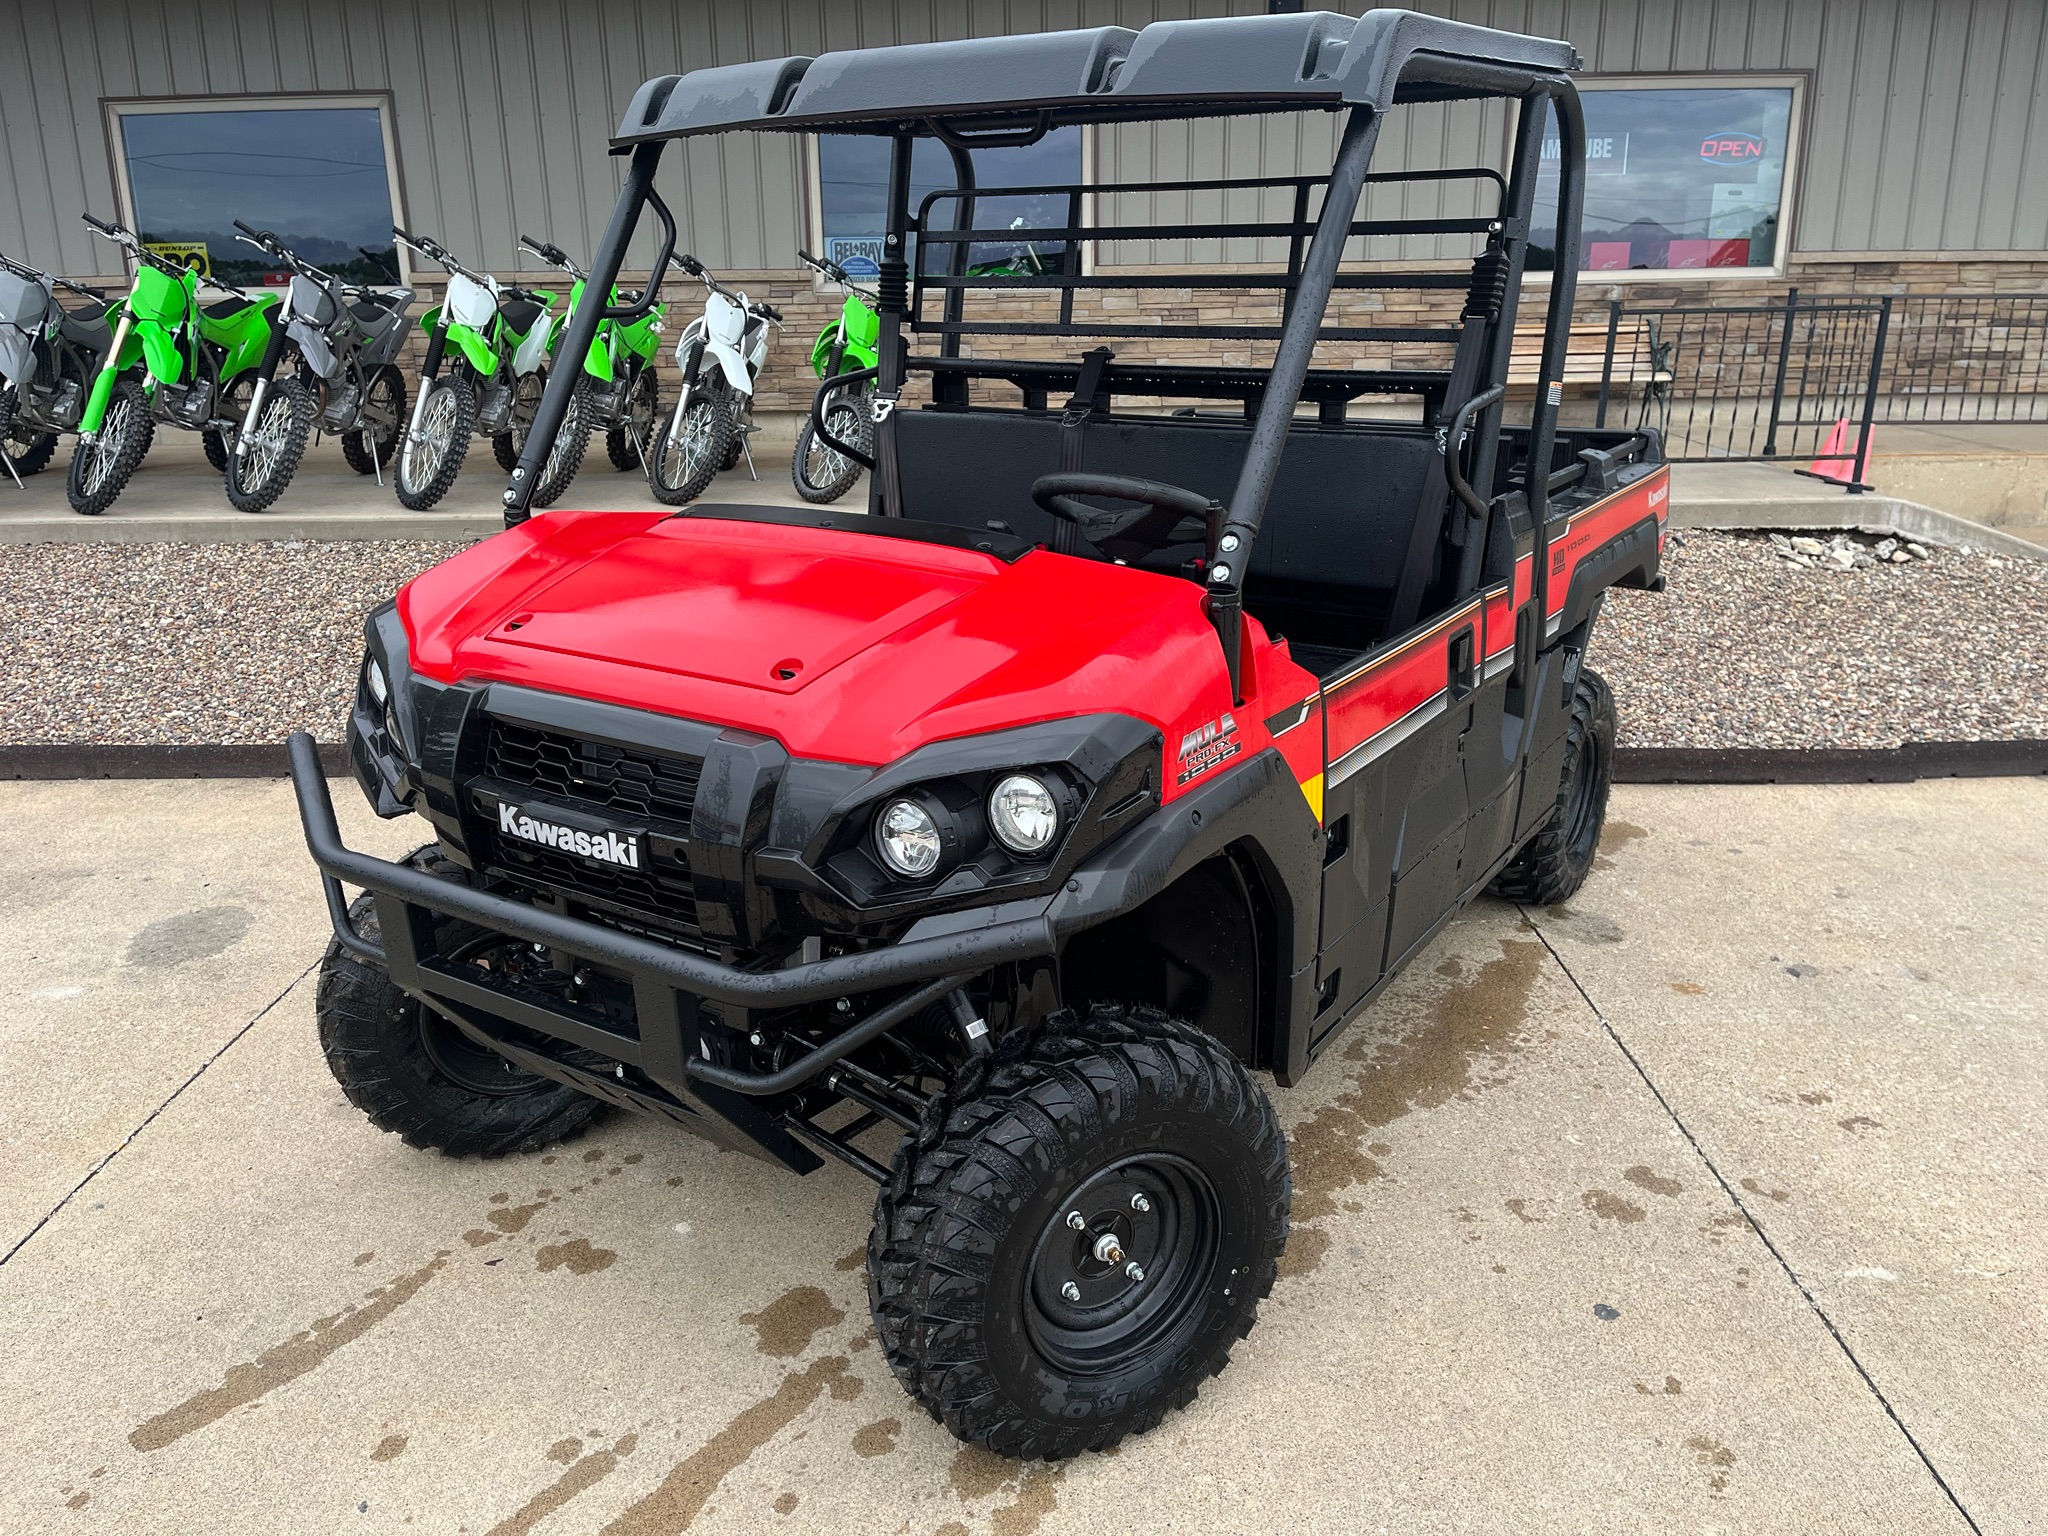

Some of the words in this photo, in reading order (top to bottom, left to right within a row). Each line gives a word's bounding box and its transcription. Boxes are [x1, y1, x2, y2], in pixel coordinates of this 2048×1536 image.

[1700, 140, 1762, 157] OPEN
[1554, 548, 1565, 566] HD
[1567, 534, 1591, 552] 1000
[1178, 713, 1238, 764] MULE
[1183, 746, 1237, 781] 1000
[498, 802, 638, 868] Kawasaki
